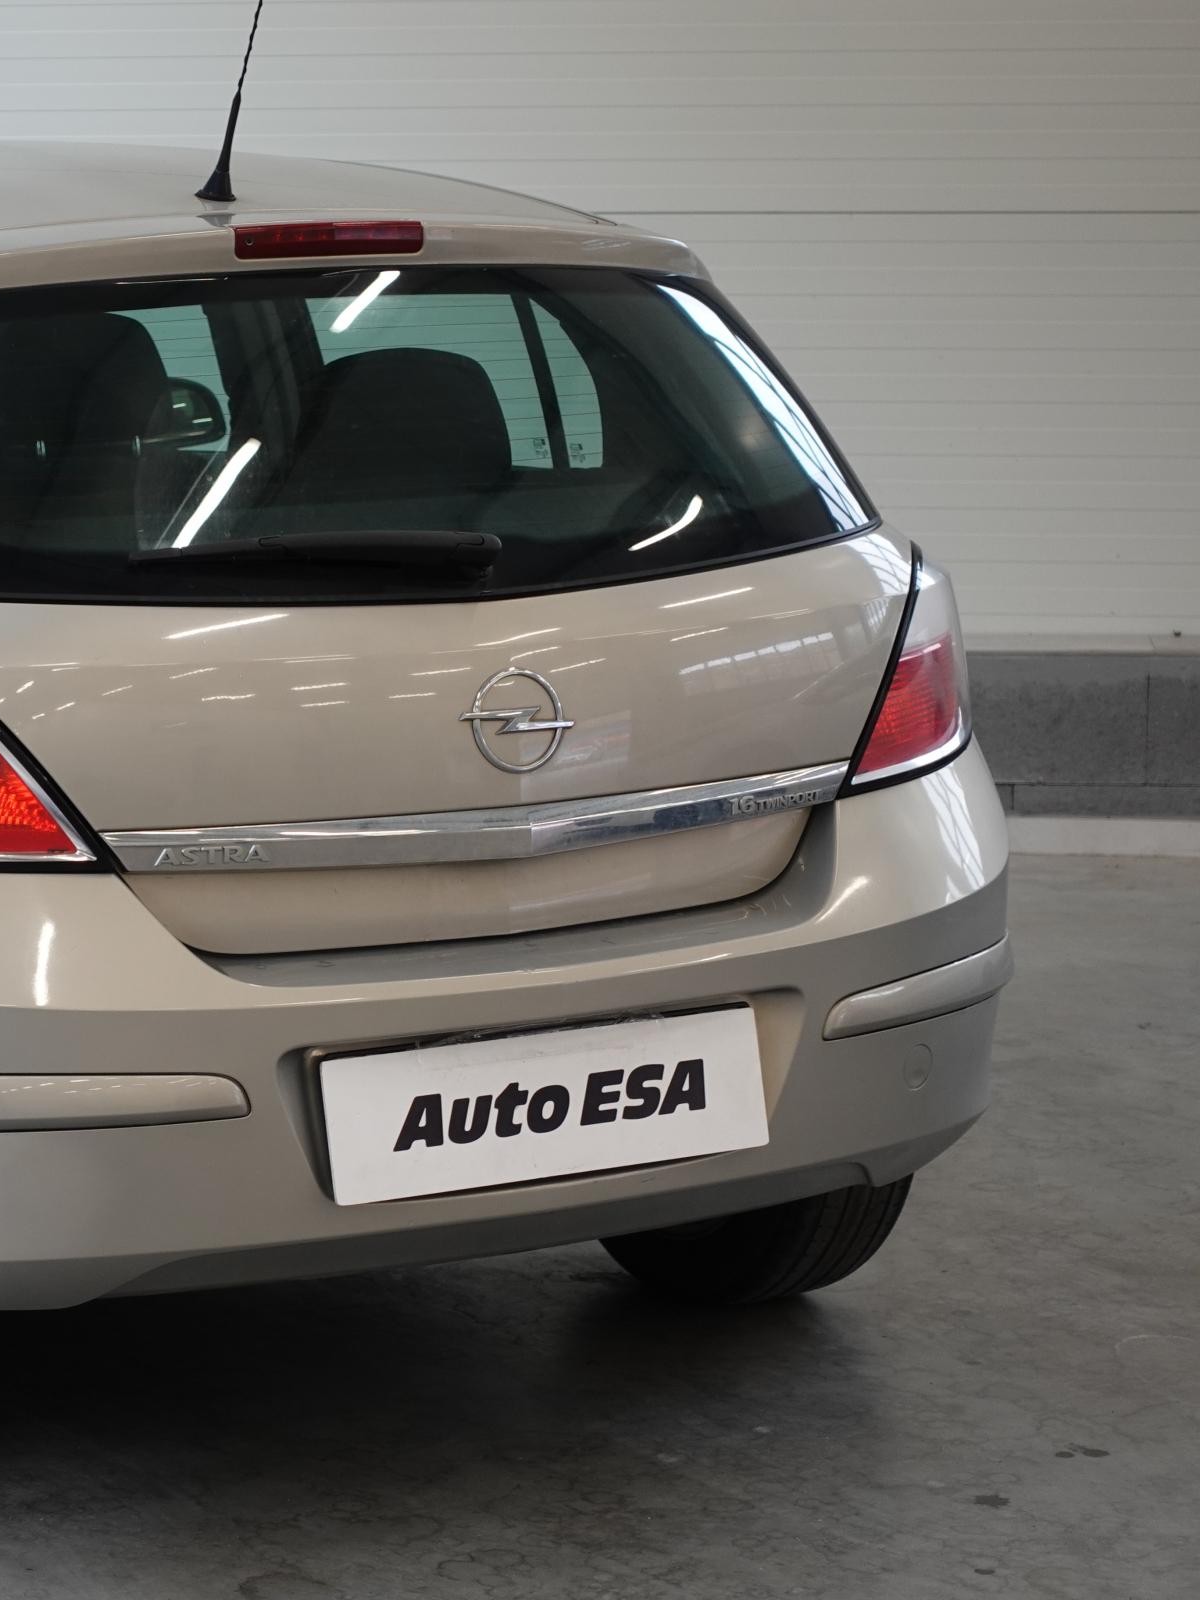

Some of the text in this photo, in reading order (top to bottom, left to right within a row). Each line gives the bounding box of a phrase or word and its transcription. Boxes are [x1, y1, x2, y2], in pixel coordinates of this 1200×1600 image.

[755, 789, 822, 813] TWINPORT
[154, 844, 271, 867] ASTRA
[393, 1058, 706, 1151] Auto ESA
